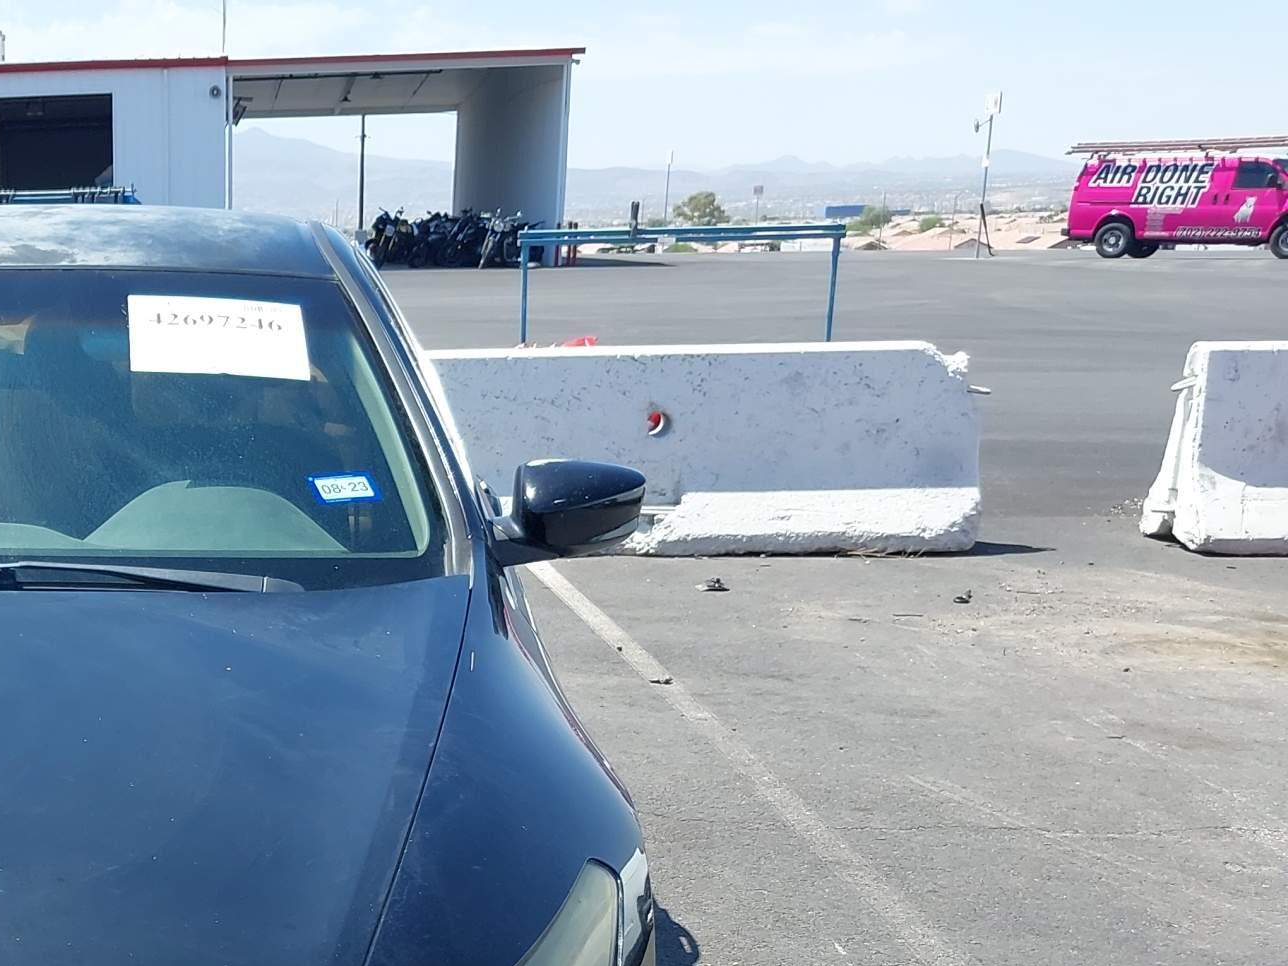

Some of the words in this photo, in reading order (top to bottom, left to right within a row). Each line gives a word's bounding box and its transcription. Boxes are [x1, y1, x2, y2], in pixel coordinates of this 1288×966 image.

[1093, 163, 1138, 184] AIR
[1141, 163, 1215, 184] DONE
[1133, 185, 1206, 205] RIGHT
[148, 312, 284, 332] 42697246
